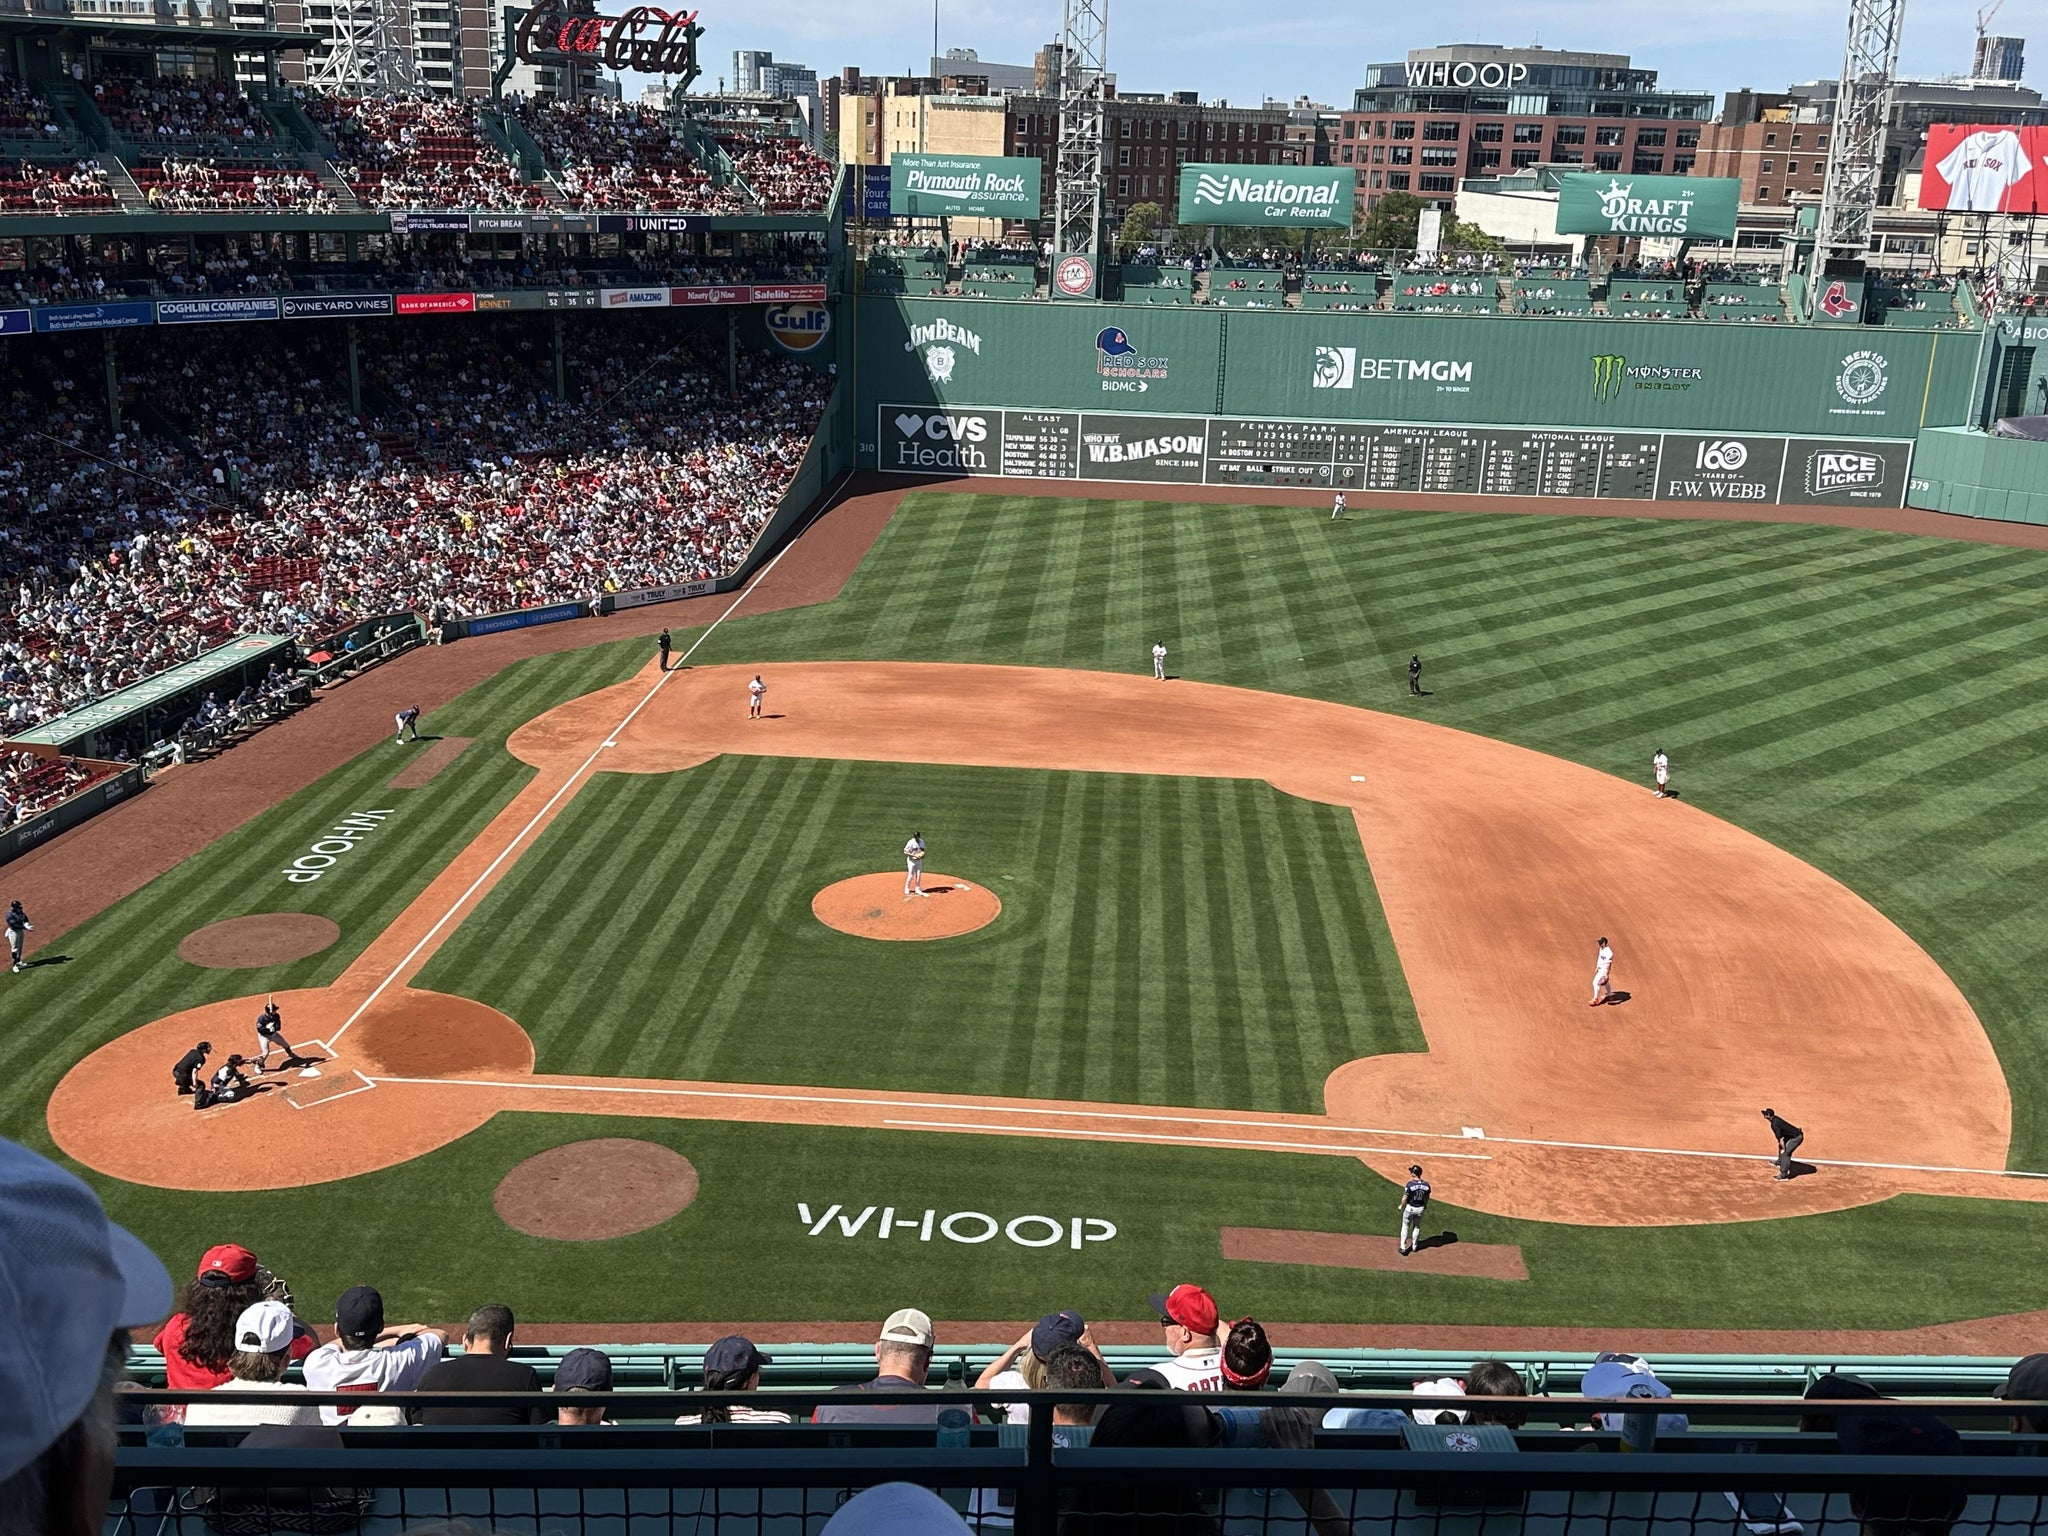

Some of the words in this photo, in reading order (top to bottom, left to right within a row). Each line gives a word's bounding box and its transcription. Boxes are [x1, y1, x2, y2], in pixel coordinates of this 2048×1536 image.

[1404, 61, 1527, 88] WHOOP
[902, 159, 920, 167] More
[920, 159, 935, 168] Than
[936, 160, 950, 168] Just
[1984, 158, 2003, 172] SOX
[907, 170, 982, 192] Plymouth
[984, 173, 1025, 192] Rock
[865, 189, 885, 198] Your
[867, 201, 888, 210] care
[1601, 197, 1693, 218] DRAFT
[1264, 206, 1287, 217] Car
[1290, 206, 1332, 218] Rental
[478, 220, 499, 228] PITCH
[500, 220, 523, 228] BREAK
[640, 218, 687, 230] UNITED
[1610, 215, 1687, 233] KINGS
[629, 293, 662, 302] AMAZING
[688, 291, 708, 301] Ninety
[720, 290, 735, 299] Nine
[755, 290, 790, 299] Safelite
[160, 303, 210, 313] COGHLIN
[211, 301, 277, 311] COMPANIES
[296, 300, 354, 311] VINEYARD
[356, 300, 389, 310] VINES
[401, 301, 419, 309] BANK
[479, 300, 512, 309] BENNETT
[549, 298, 558, 306] 52
[768, 308, 826, 330] Gulf
[904, 323, 935, 352] JIM
[936, 317, 982, 355] BEAM
[1103, 356, 1132, 367] RED
[1138, 357, 1168, 369] SOX
[1841, 351, 1871, 367] IBEW
[1871, 352, 1888, 368] 103
[1102, 366, 1167, 379] SCHOLARS
[1360, 358, 1473, 382] BETMGM
[1102, 380, 1136, 392] BIDMC
[925, 414, 987, 442] CVS
[1240, 423, 1293, 431] FENWAY
[1302, 425, 1337, 433] PARK
[1383, 428, 1430, 436] AMERICAN
[1083, 435, 1103, 443] WHO
[1104, 435, 1120, 443] BUT
[1532, 433, 1575, 441] NATIONAL
[859, 442, 874, 452] 310
[898, 441, 987, 468] Health
[1695, 440, 1747, 470] 160
[1004, 459, 1036, 467] BALTIMORE
[1155, 459, 1179, 467] SINCE
[1821, 454, 1876, 472] ACE
[1821, 472, 1875, 486] TICKET
[1708, 482, 1766, 499] WEBB
[1909, 481, 1930, 492] 379
[688, 584, 705, 593] TRULY
[647, 590, 665, 599] TRULY
[540, 610, 573, 620] HONDA
[485, 618, 519, 629] HONDA
[33, 820, 55, 839] TICKET
[281, 809, 395, 883] WHOOP
[797, 1203, 1117, 1250] WHOOP
